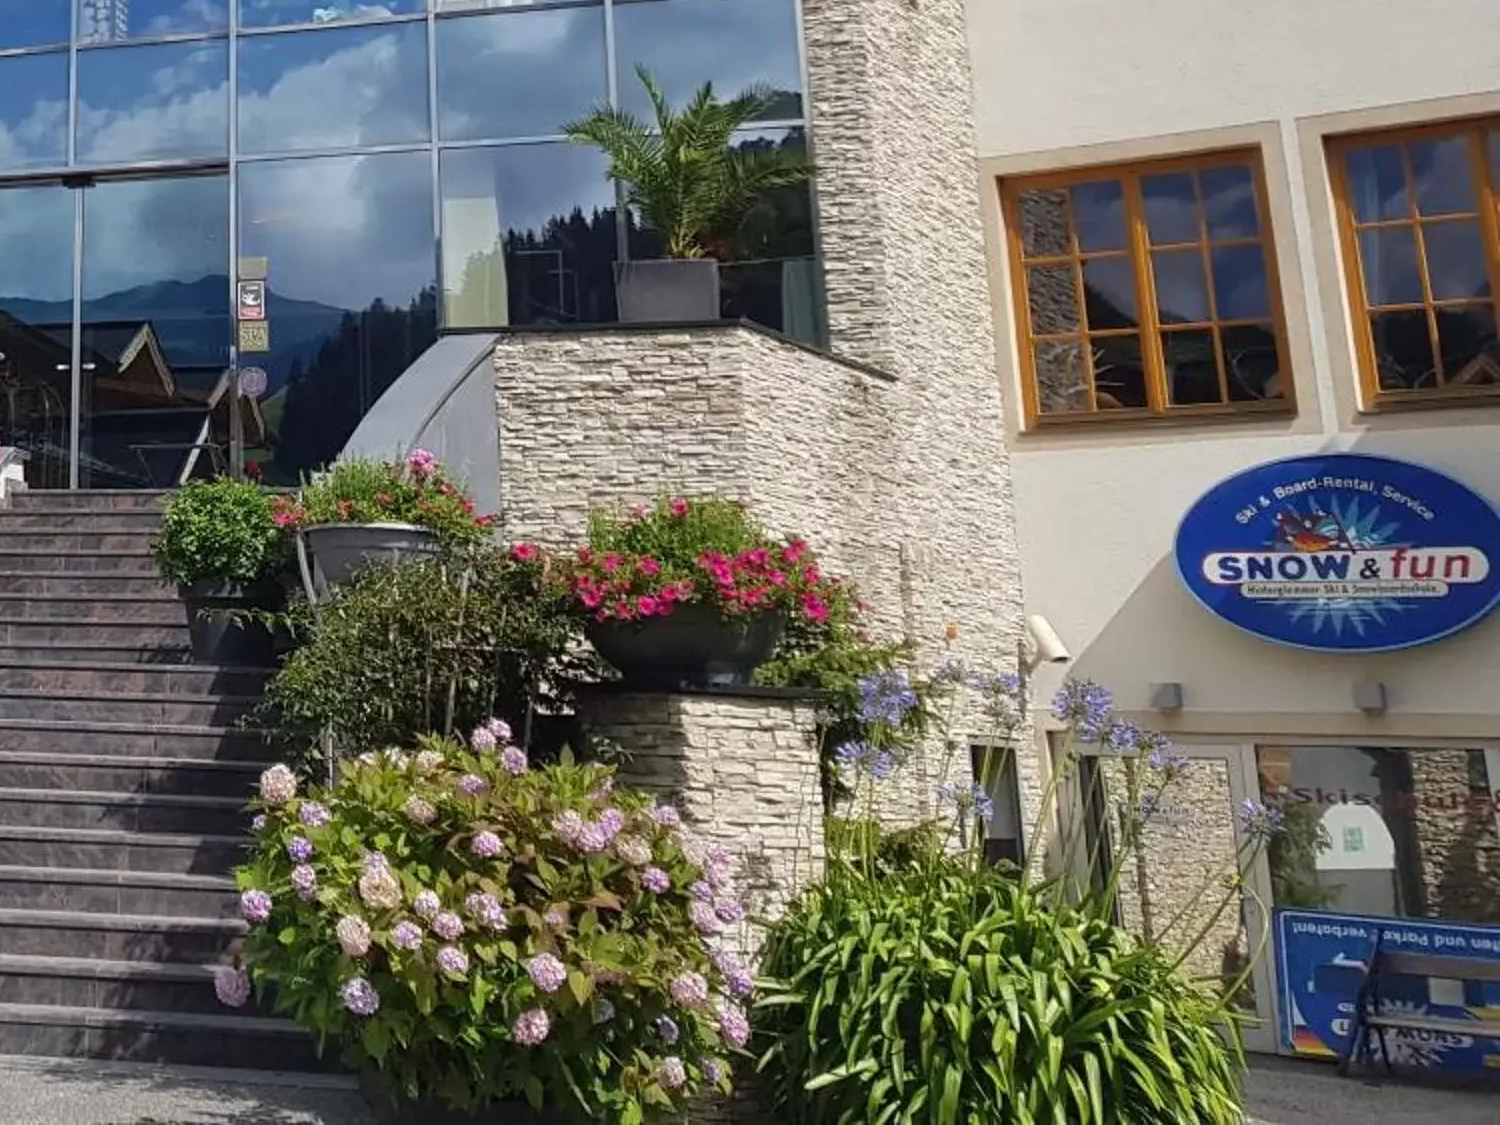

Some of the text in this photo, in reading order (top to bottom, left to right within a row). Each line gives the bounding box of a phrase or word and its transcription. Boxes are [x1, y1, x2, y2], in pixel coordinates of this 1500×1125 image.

[1382, 485, 1435, 521] Service
[1218, 547, 1472, 580] SNOW & fun
[1435, 932, 1467, 948] und
